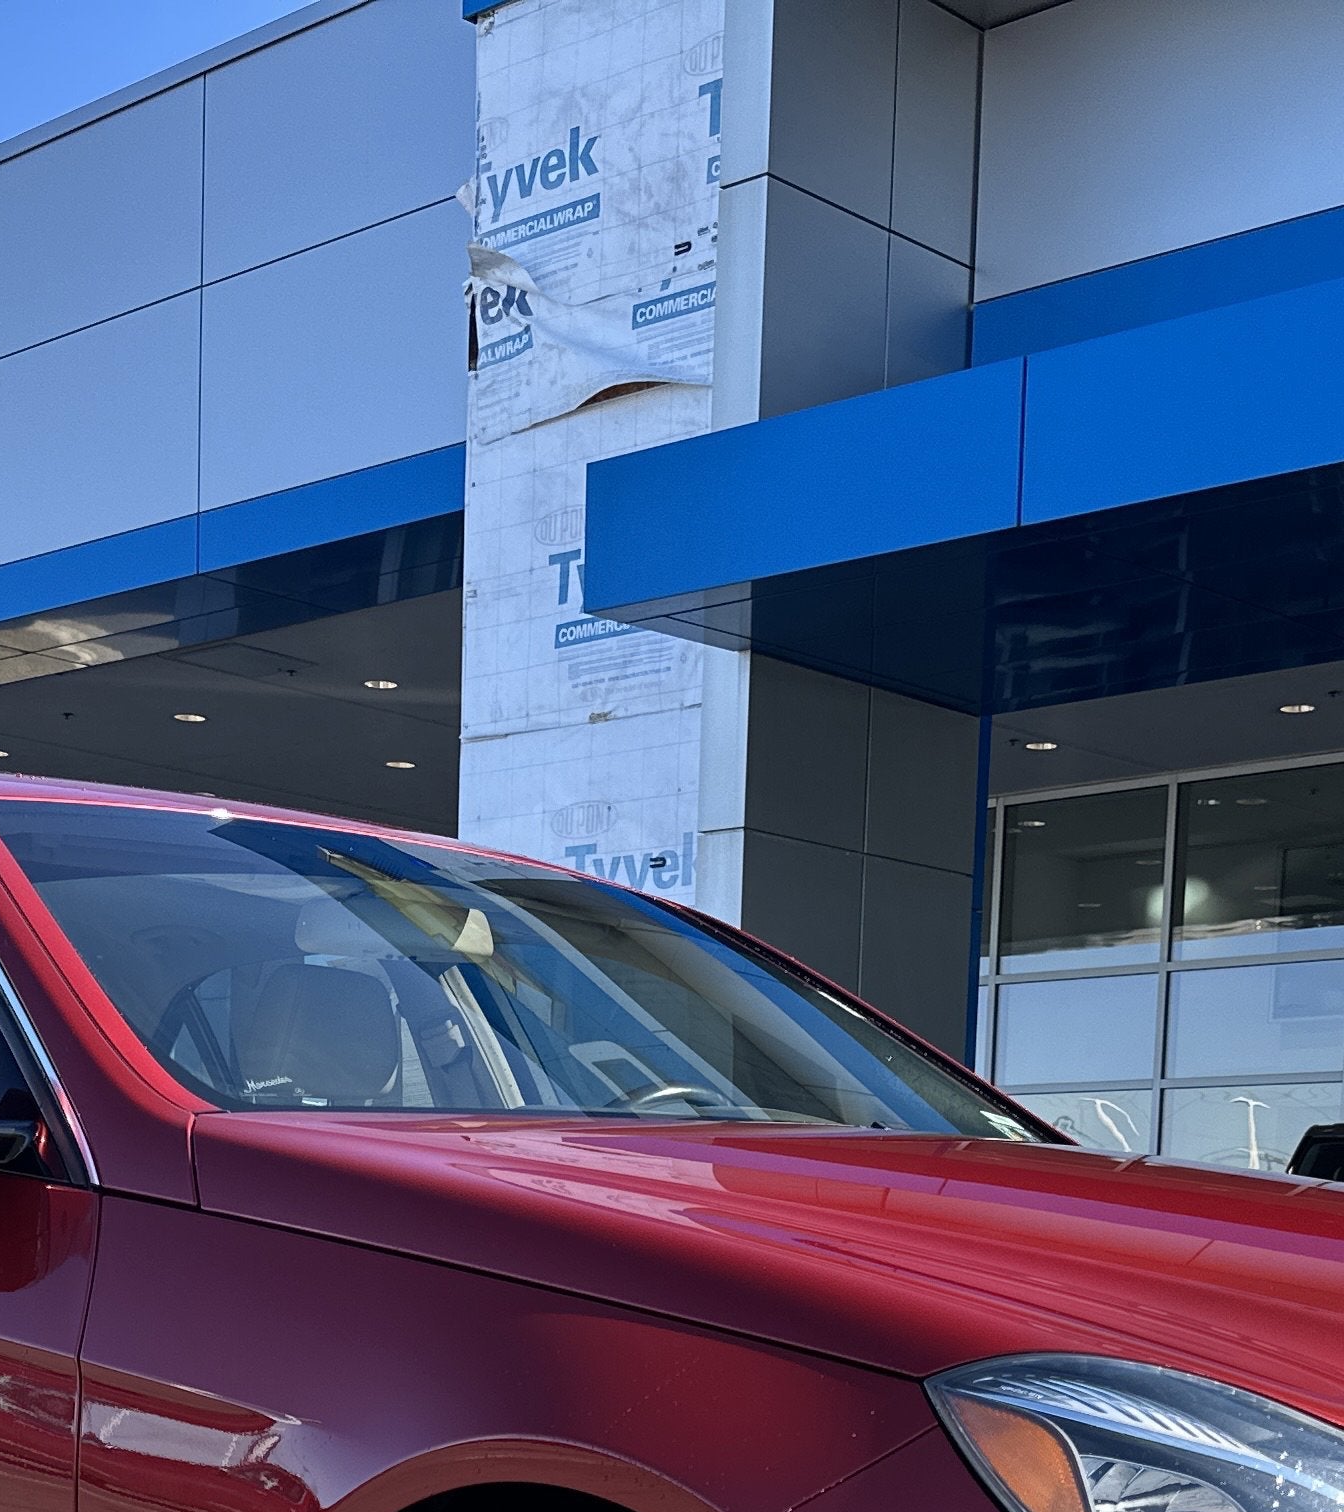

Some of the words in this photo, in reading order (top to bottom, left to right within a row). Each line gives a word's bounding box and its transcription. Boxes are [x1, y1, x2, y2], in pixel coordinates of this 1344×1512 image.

[481, 200, 595, 249] OMMERCIALWRAP
[558, 619, 630, 643] COMMERC
[243, 1075, 293, 1094] Mercedes
